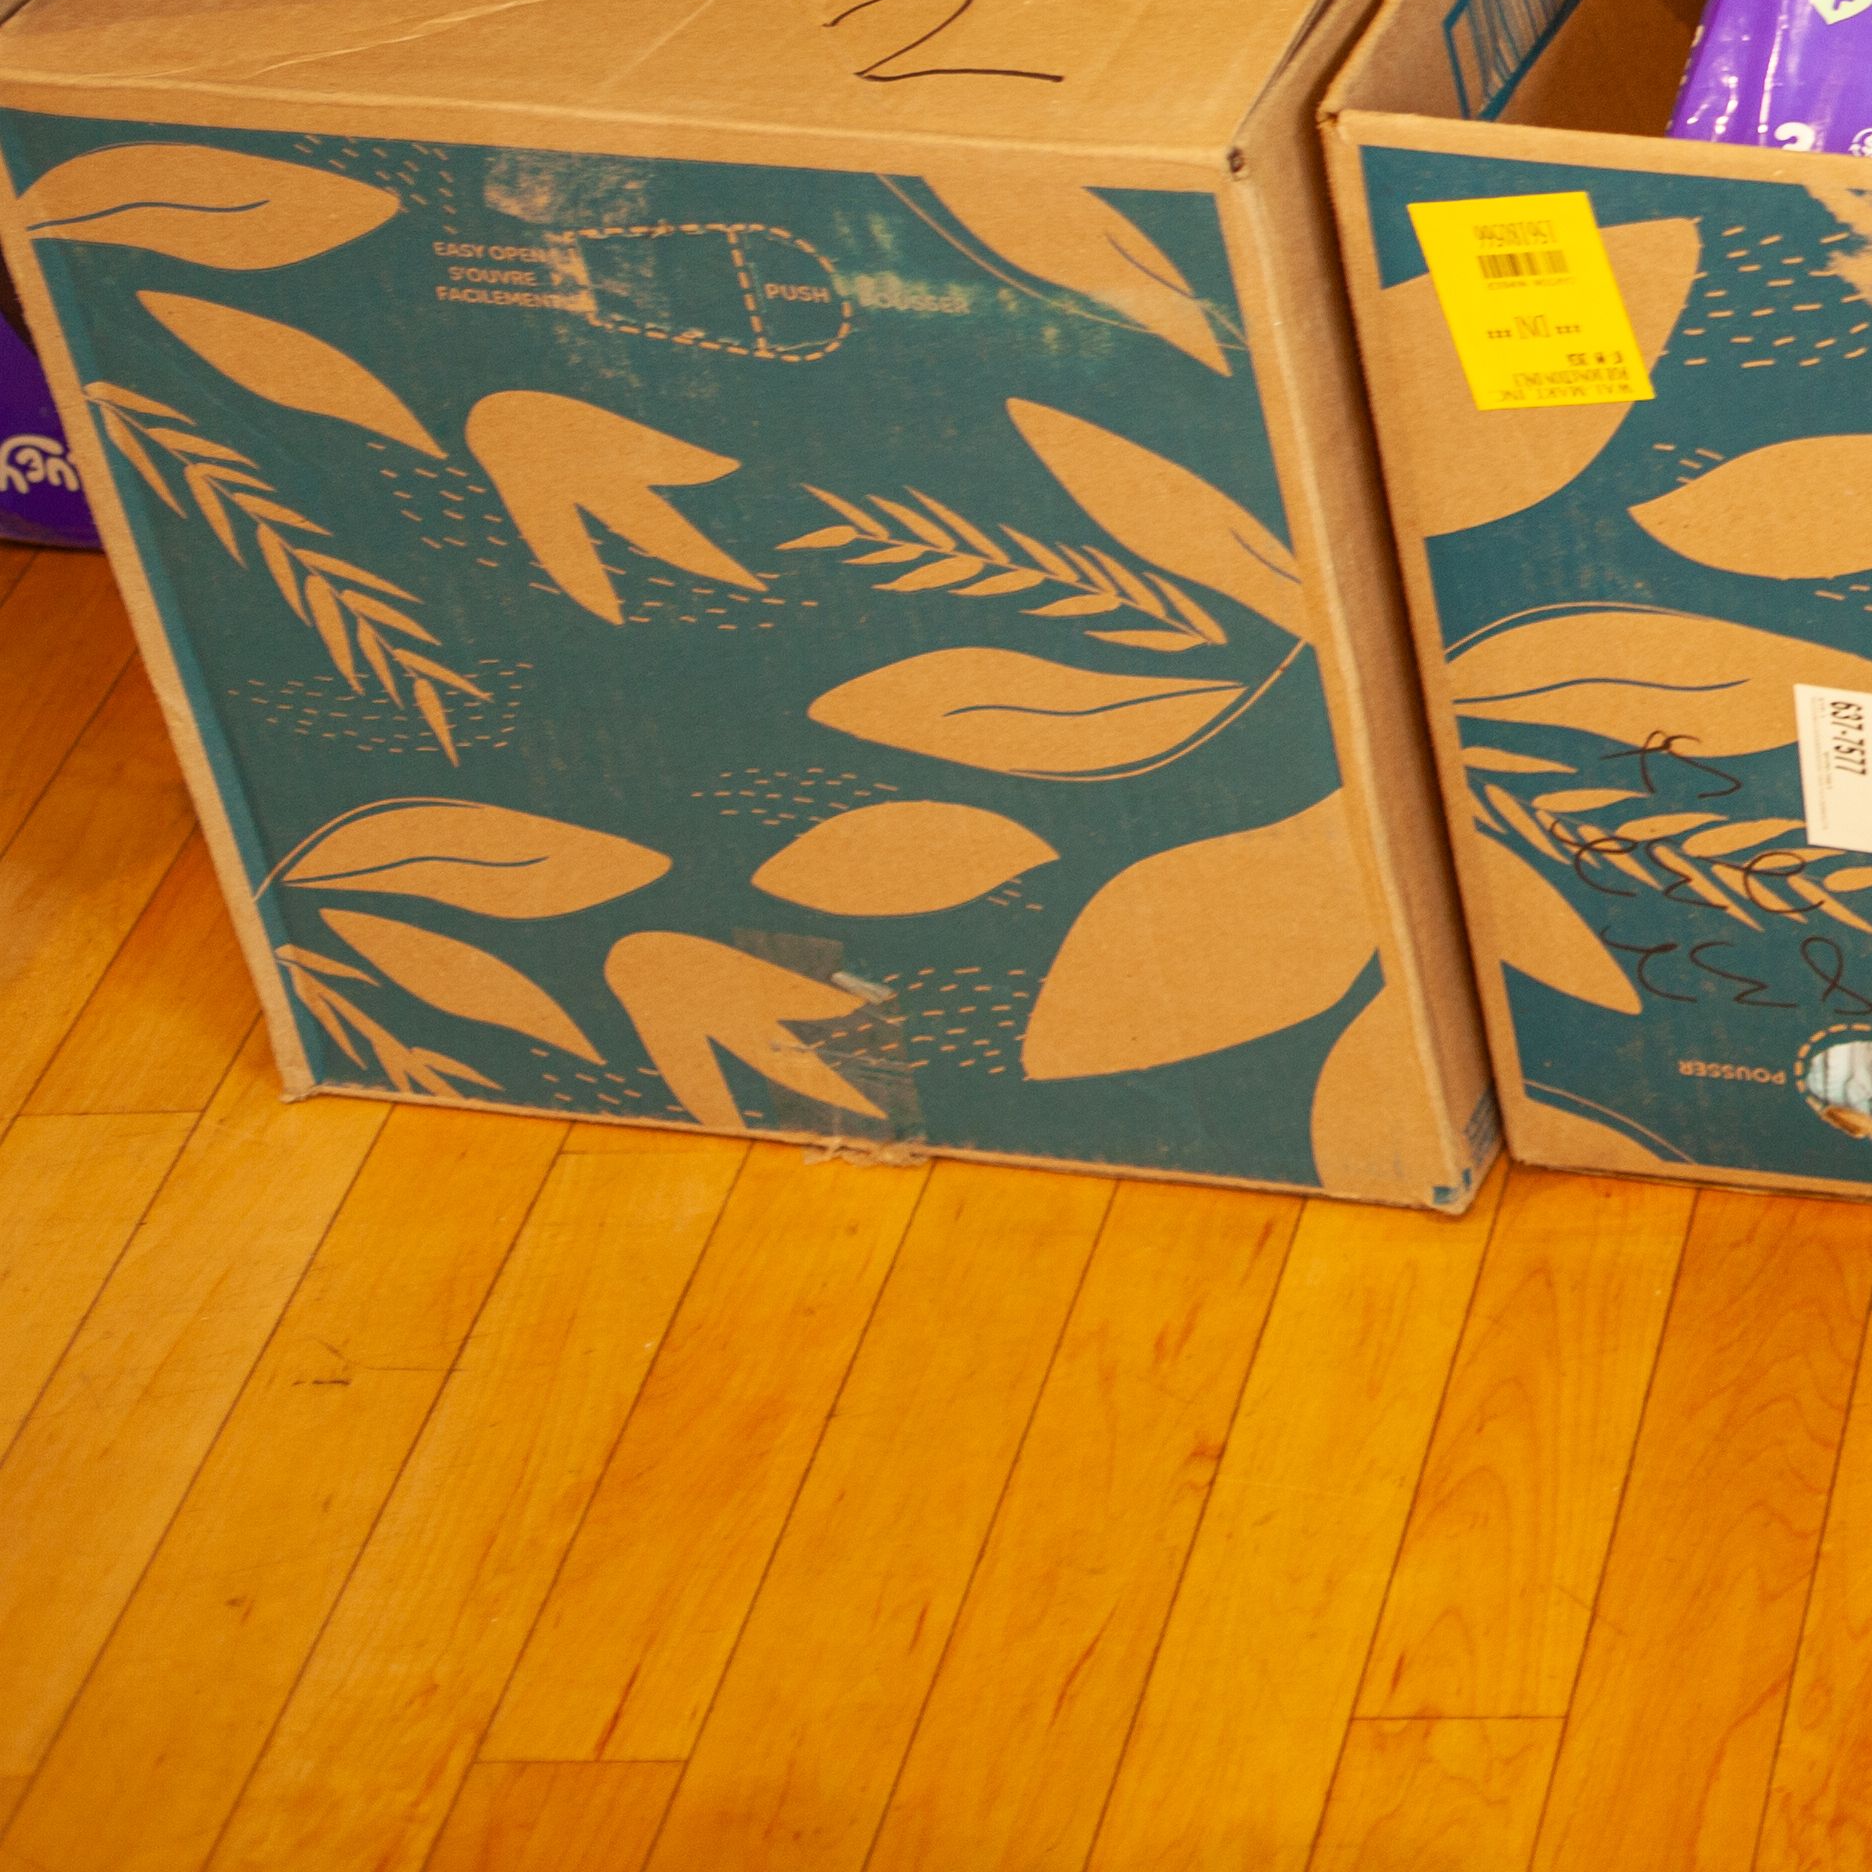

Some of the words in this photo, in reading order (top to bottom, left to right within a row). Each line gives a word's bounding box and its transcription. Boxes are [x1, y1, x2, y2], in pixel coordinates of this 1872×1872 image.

[432, 240, 486, 261] EASY
[765, 281, 831, 305] PUSH
[1678, 1059, 1786, 1086] POUSSER
